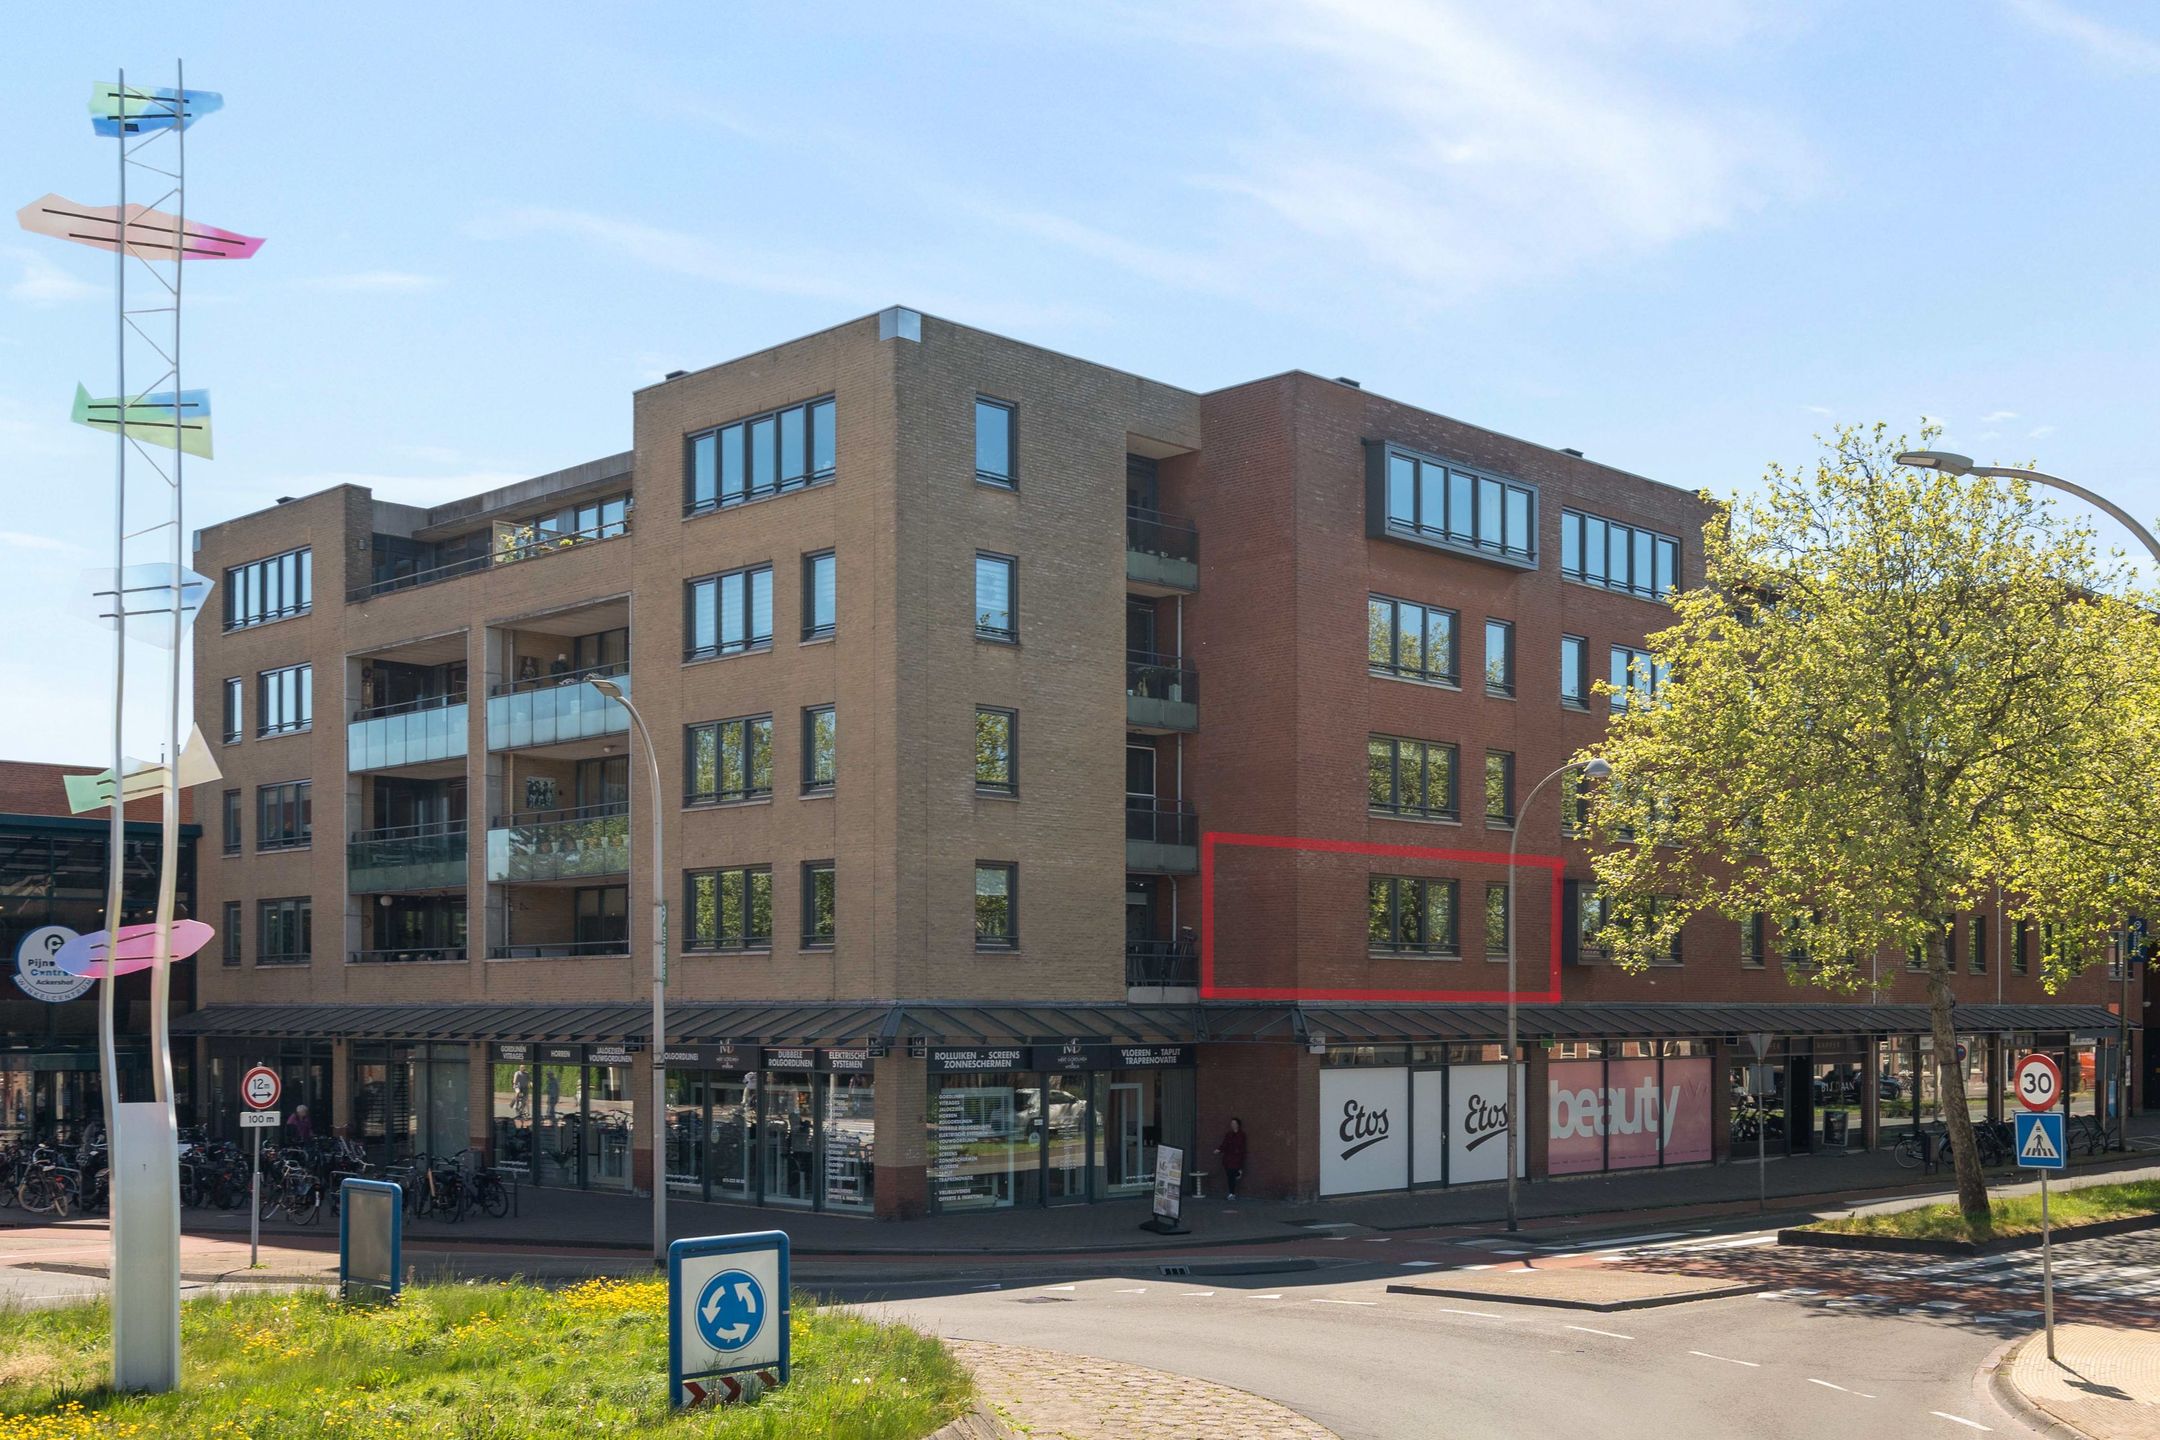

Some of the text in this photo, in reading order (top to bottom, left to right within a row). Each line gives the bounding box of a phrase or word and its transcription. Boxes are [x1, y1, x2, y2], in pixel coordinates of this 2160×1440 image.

[550, 1050, 571, 1058] HORREN
[664, 1052, 699, 1061] OLGORDIJNE
[777, 1050, 803, 1059] DUBBELE
[829, 1051, 866, 1060] ELEKTRISCHE
[934, 1051, 976, 1060] ROLLUIKEN
[988, 1051, 1020, 1060] SCREENS
[1121, 1048, 1151, 1057] VLOEREN
[1160, 1048, 1181, 1056] TAPIJT
[768, 1058, 813, 1067] ROLGORDIJNEN
[832, 1060, 863, 1069] SYSTEMEN
[944, 1060, 1012, 1069] ZONNESCHERMEN
[1125, 1056, 1177, 1065] TRAPRENOVATIE
[2023, 1073, 2052, 1094] 30
[1464, 1094, 1508, 1134] Etos
[1550, 1076, 1681, 1150] beauty
[248, 1115, 264, 1123] 100
[1339, 1099, 1389, 1142] Etos
